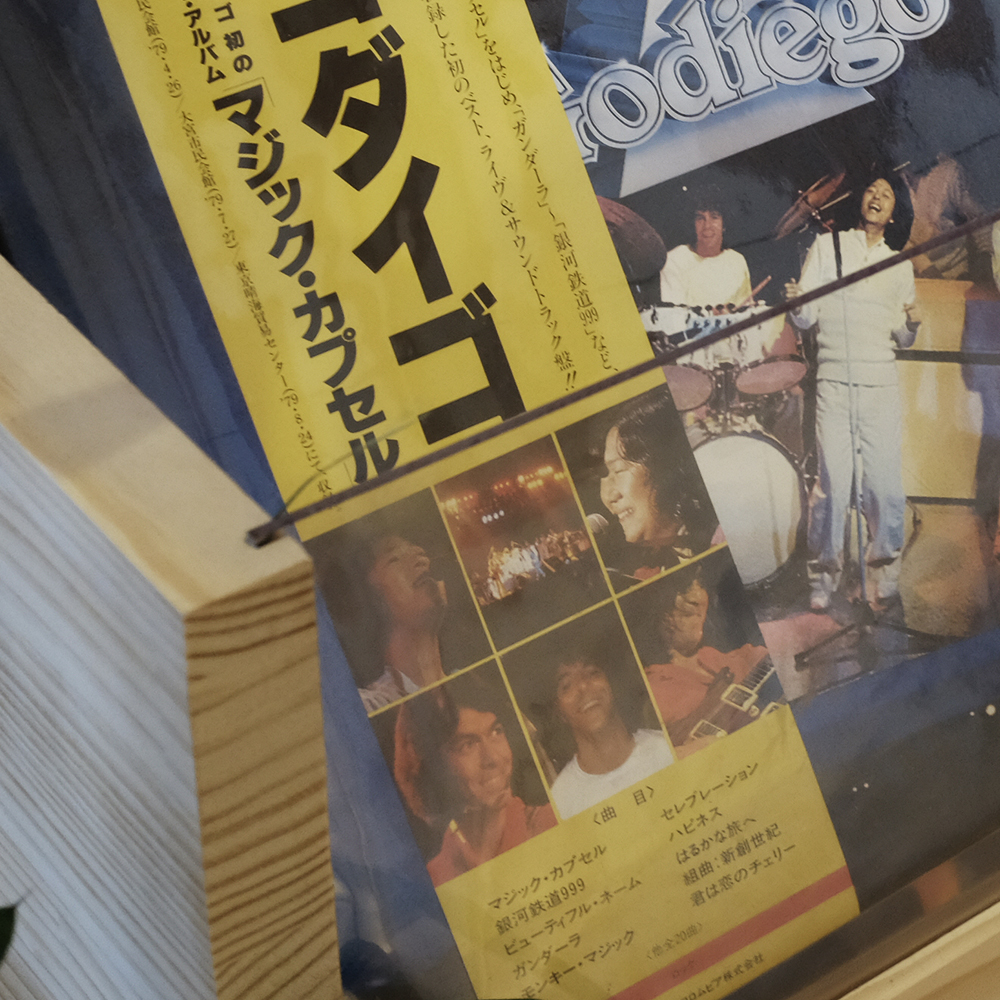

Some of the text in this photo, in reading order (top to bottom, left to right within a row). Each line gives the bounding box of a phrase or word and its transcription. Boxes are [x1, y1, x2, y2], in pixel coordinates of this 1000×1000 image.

[660, 761, 759, 822] セレブレーション
[675, 817, 758, 865] はるかな旅へ
[689, 843, 797, 908] 君は恋のチェリー
[494, 878, 587, 936] 銀河鉄道999
[503, 876, 643, 957] ビューティフル・ネーム
[512, 931, 583, 981] ガンダーラ
